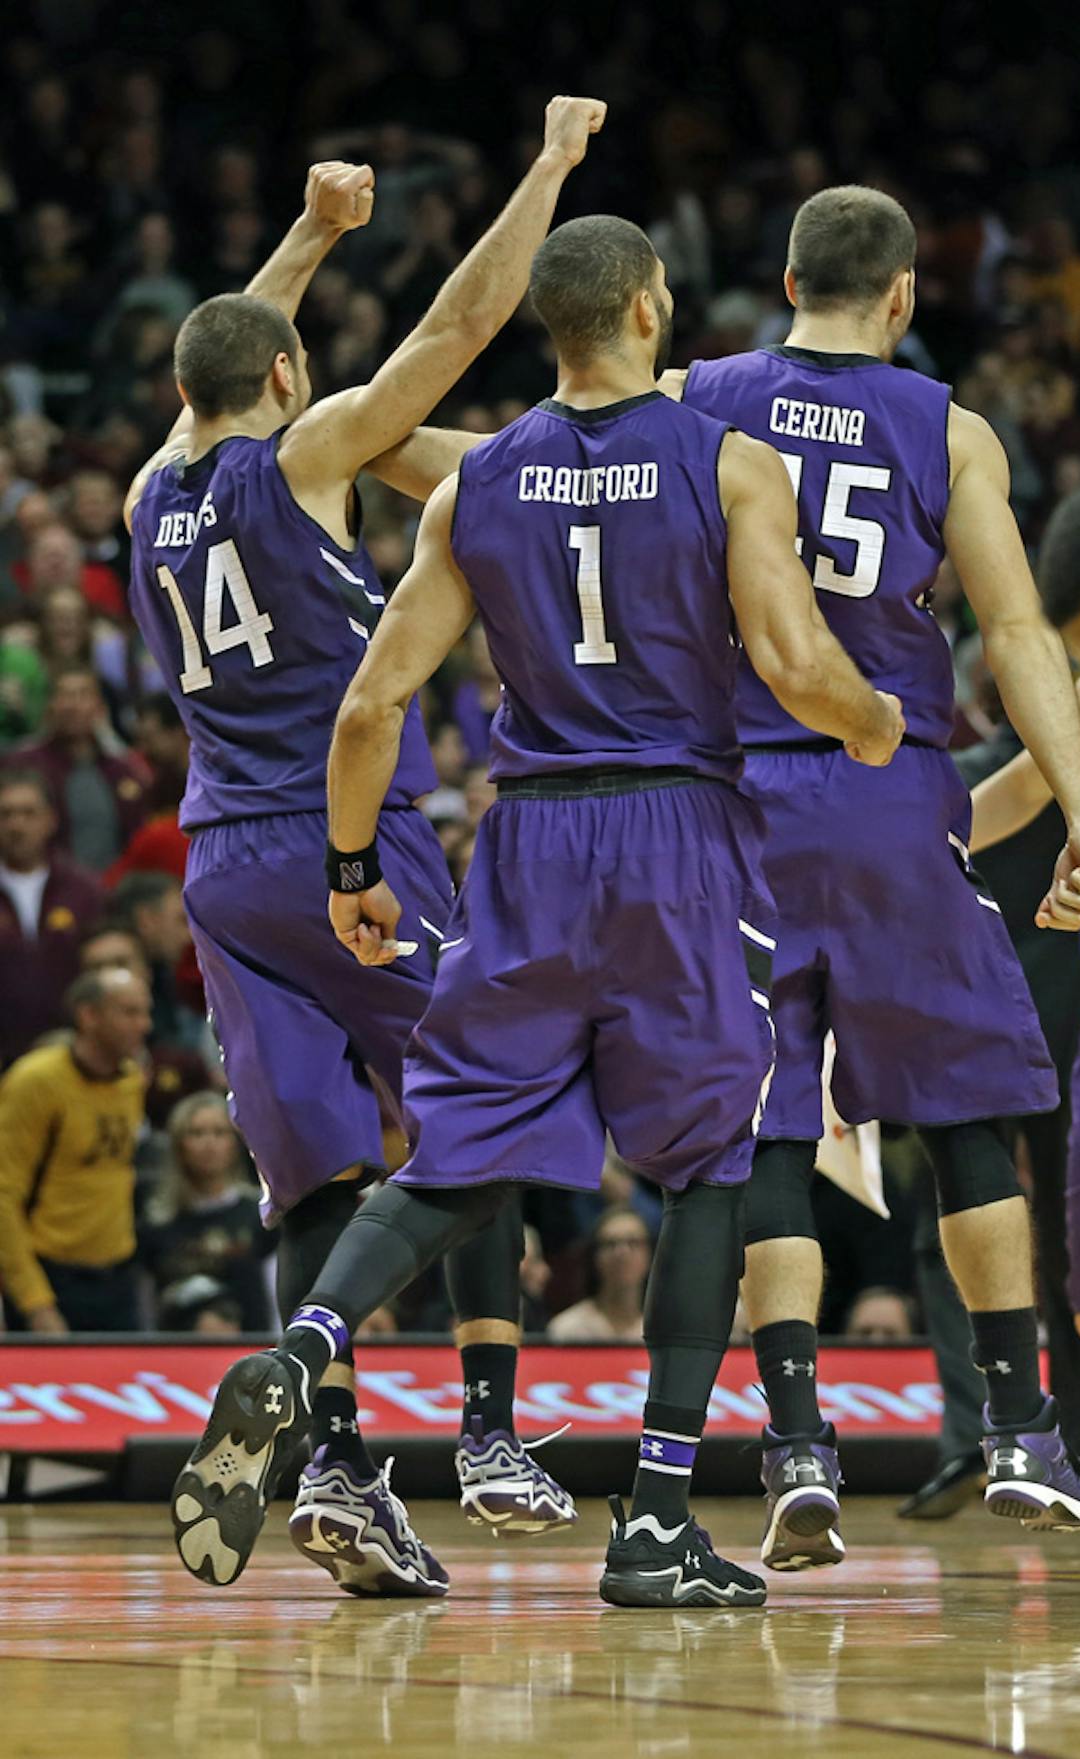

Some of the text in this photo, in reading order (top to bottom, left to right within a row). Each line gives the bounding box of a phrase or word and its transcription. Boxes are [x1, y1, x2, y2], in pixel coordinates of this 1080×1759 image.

[769, 397, 866, 447] CERINA
[518, 461, 659, 507] CRAWFORD
[156, 538, 275, 694] 14
[569, 524, 617, 665] 1
